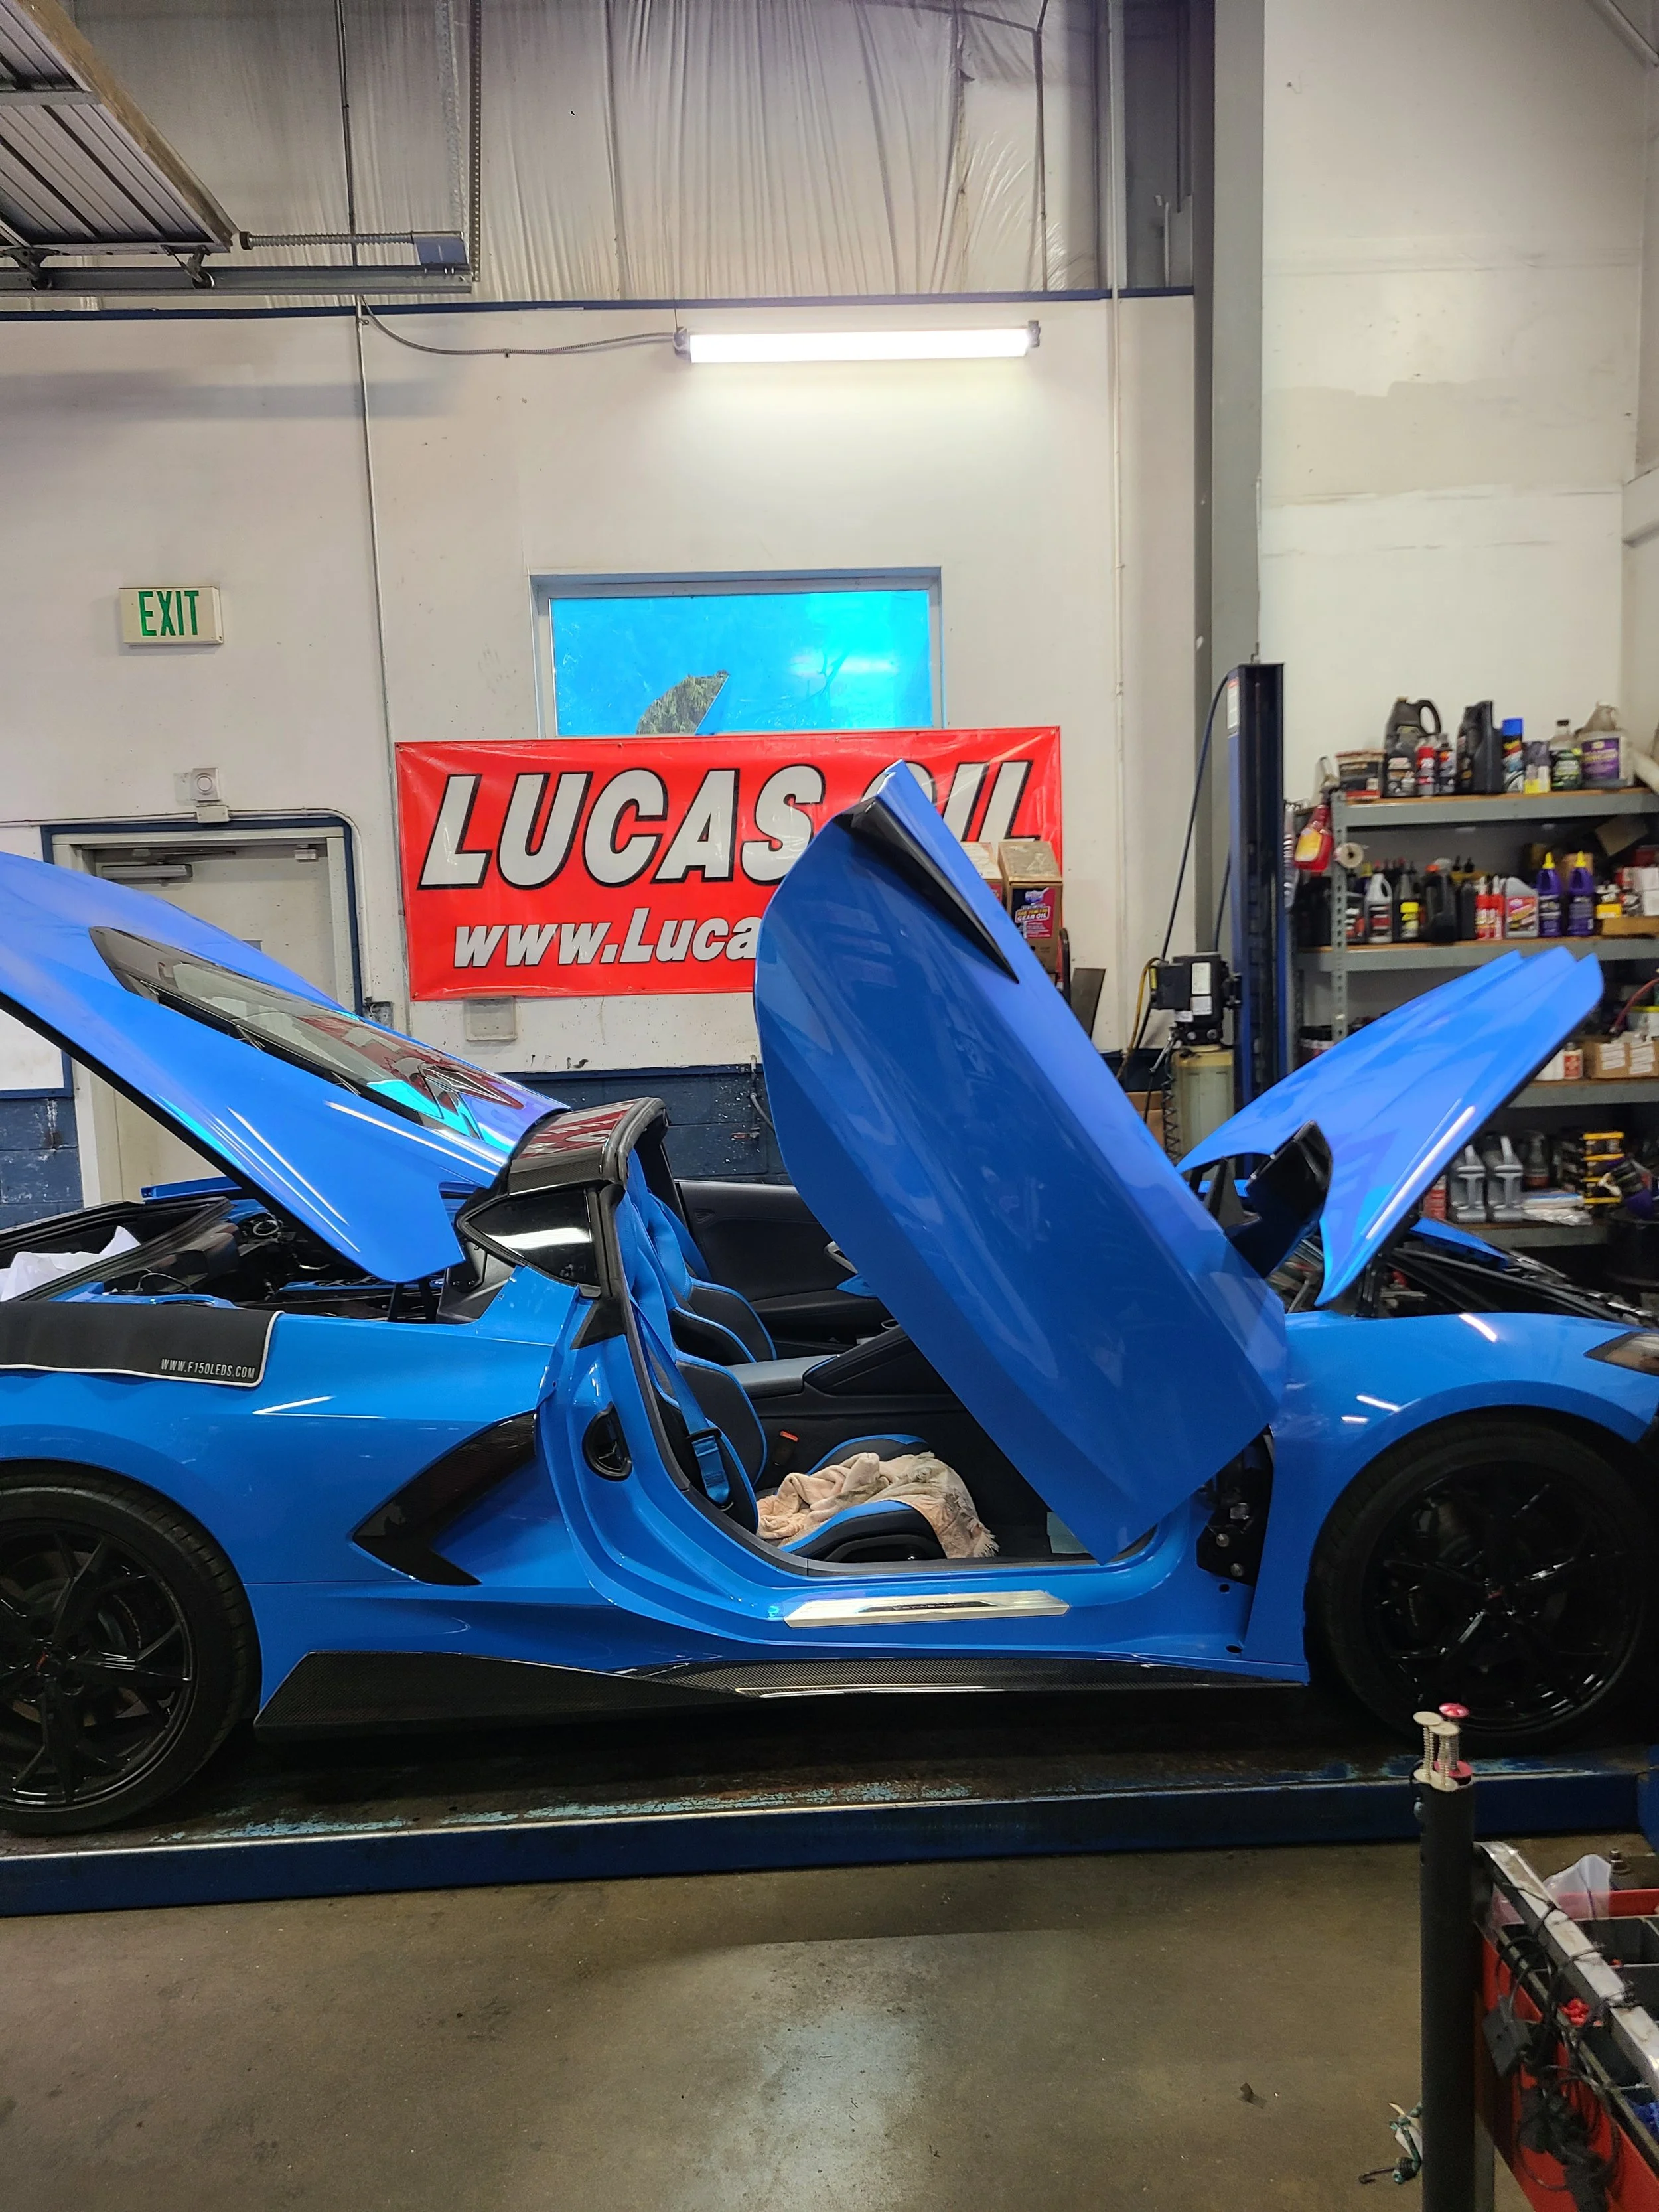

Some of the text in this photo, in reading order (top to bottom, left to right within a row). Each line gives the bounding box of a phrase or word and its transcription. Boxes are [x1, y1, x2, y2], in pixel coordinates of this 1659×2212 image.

[138, 590, 199, 636] EXIT
[417, 760, 1041, 890] LUCAS IL
[161, 1359, 255, 1379] WWW.F150LEDS.COM
